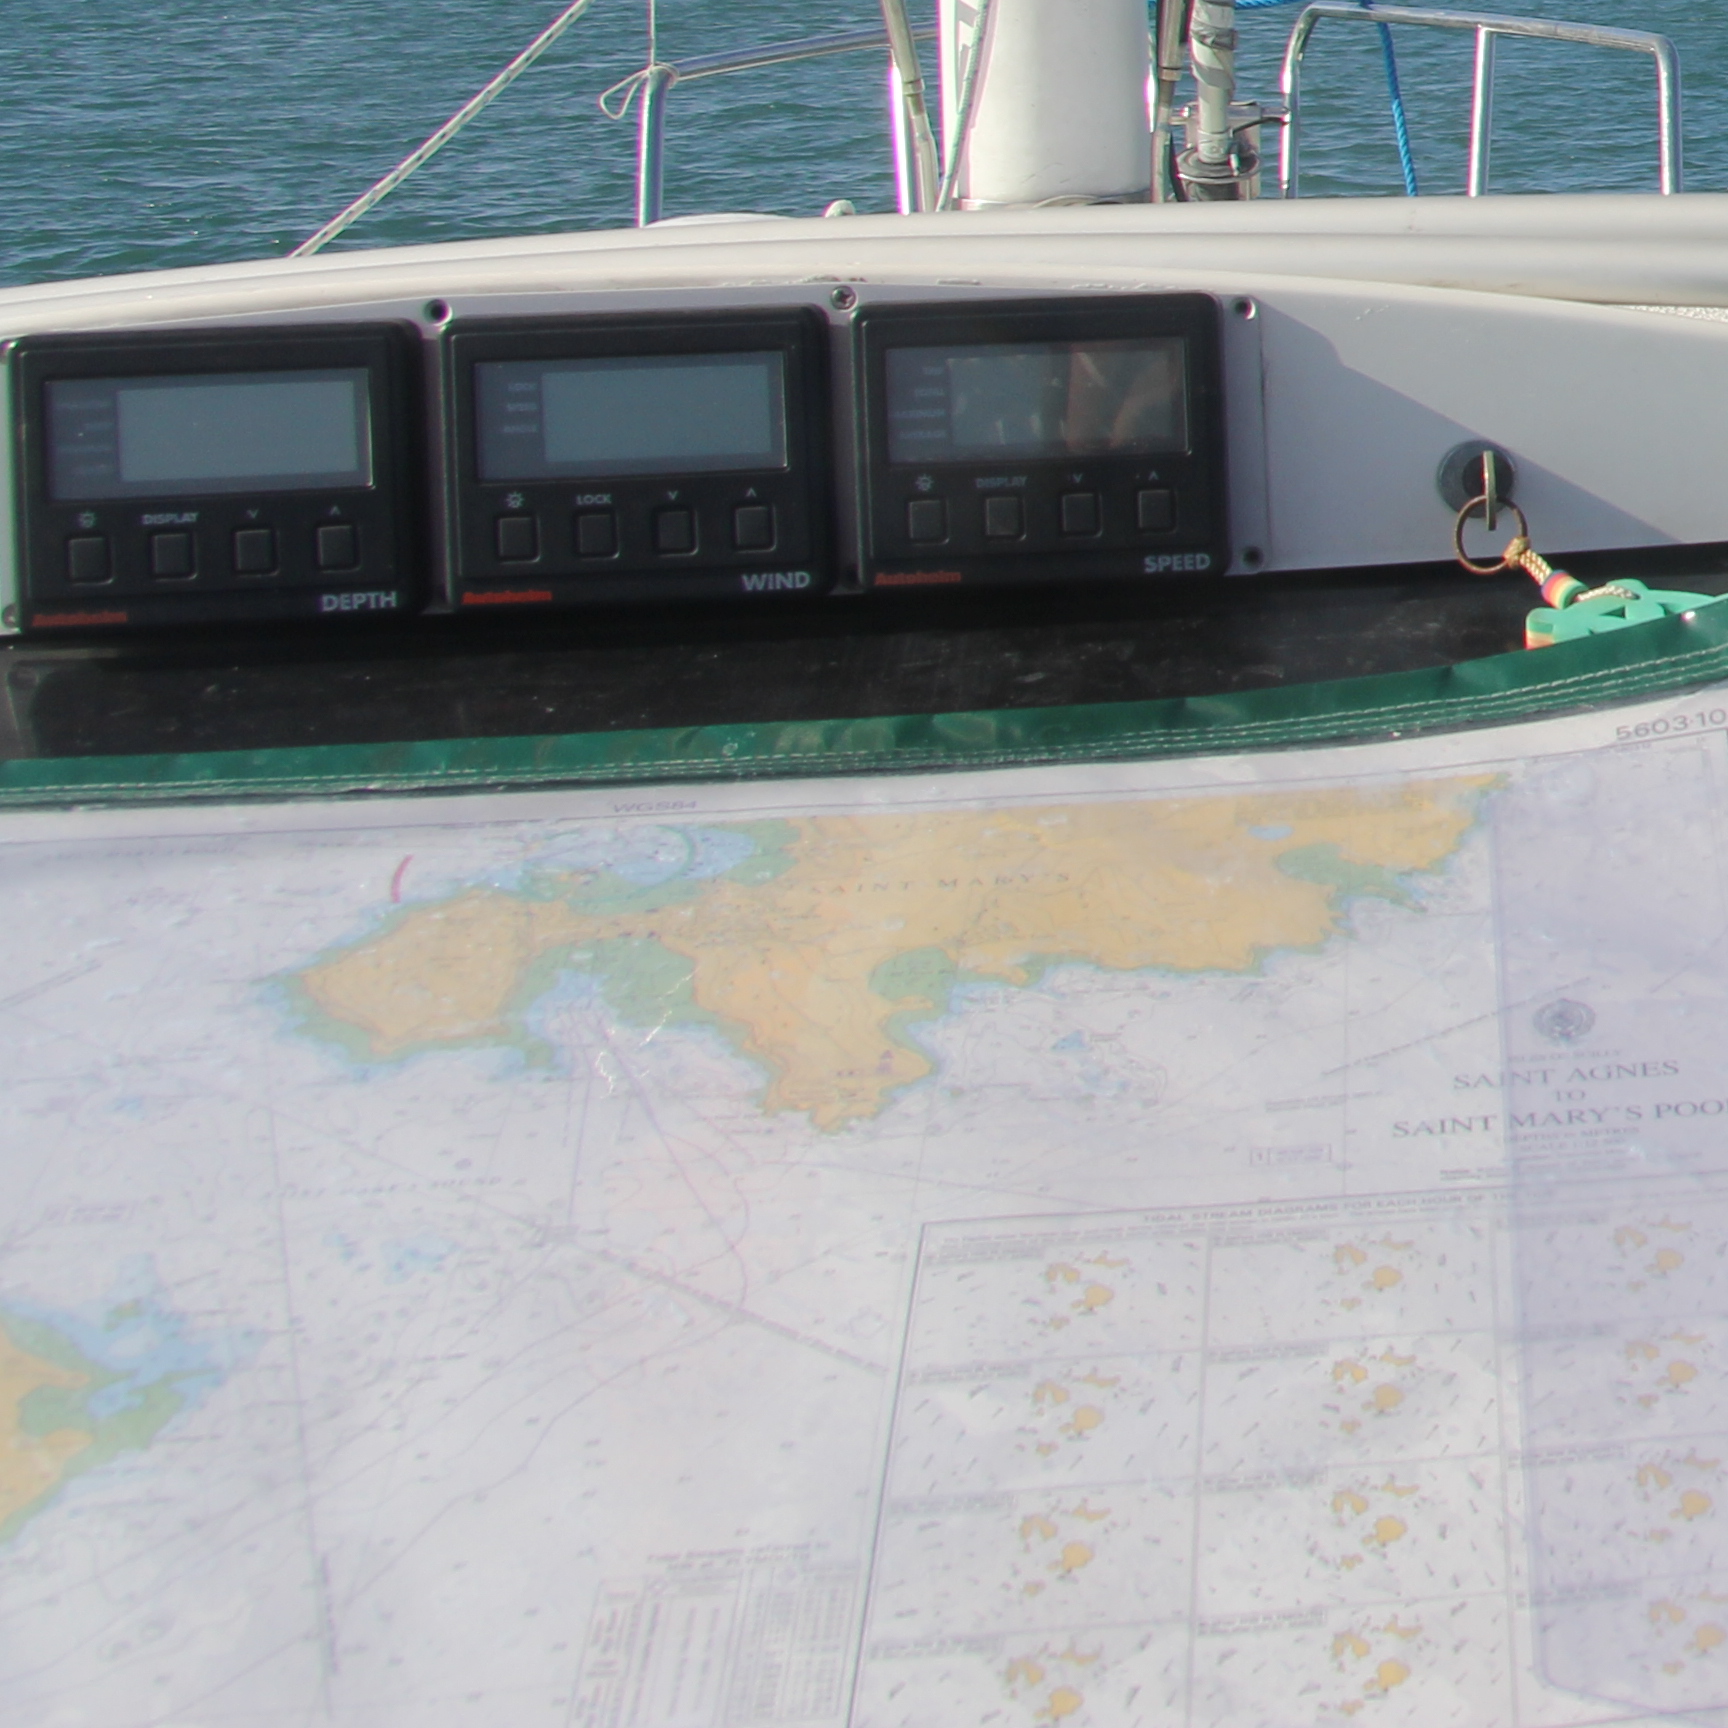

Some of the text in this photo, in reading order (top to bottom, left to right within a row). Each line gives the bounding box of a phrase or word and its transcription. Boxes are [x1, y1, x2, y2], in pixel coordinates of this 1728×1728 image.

[975, 475, 1027, 488] DISPLAY
[575, 493, 612, 505] LOCK
[142, 512, 198, 525] DISPLAY
[1143, 553, 1211, 572] SPEED
[740, 572, 811, 592] WIND
[321, 590, 397, 612] DEPTH
[1453, 1059, 1680, 1090] SAINT AGNES
[1556, 1089, 1586, 1102] TO
[1391, 1114, 1498, 1139] SAINT
[1508, 1104, 1643, 1129] MARY'S
[1191, 1209, 1253, 1221] STREAM
[1257, 1203, 1339, 1217] DIAGRAMS
[1376, 1197, 1417, 1209] EACH
[1421, 1195, 1462, 1206] HOUR
